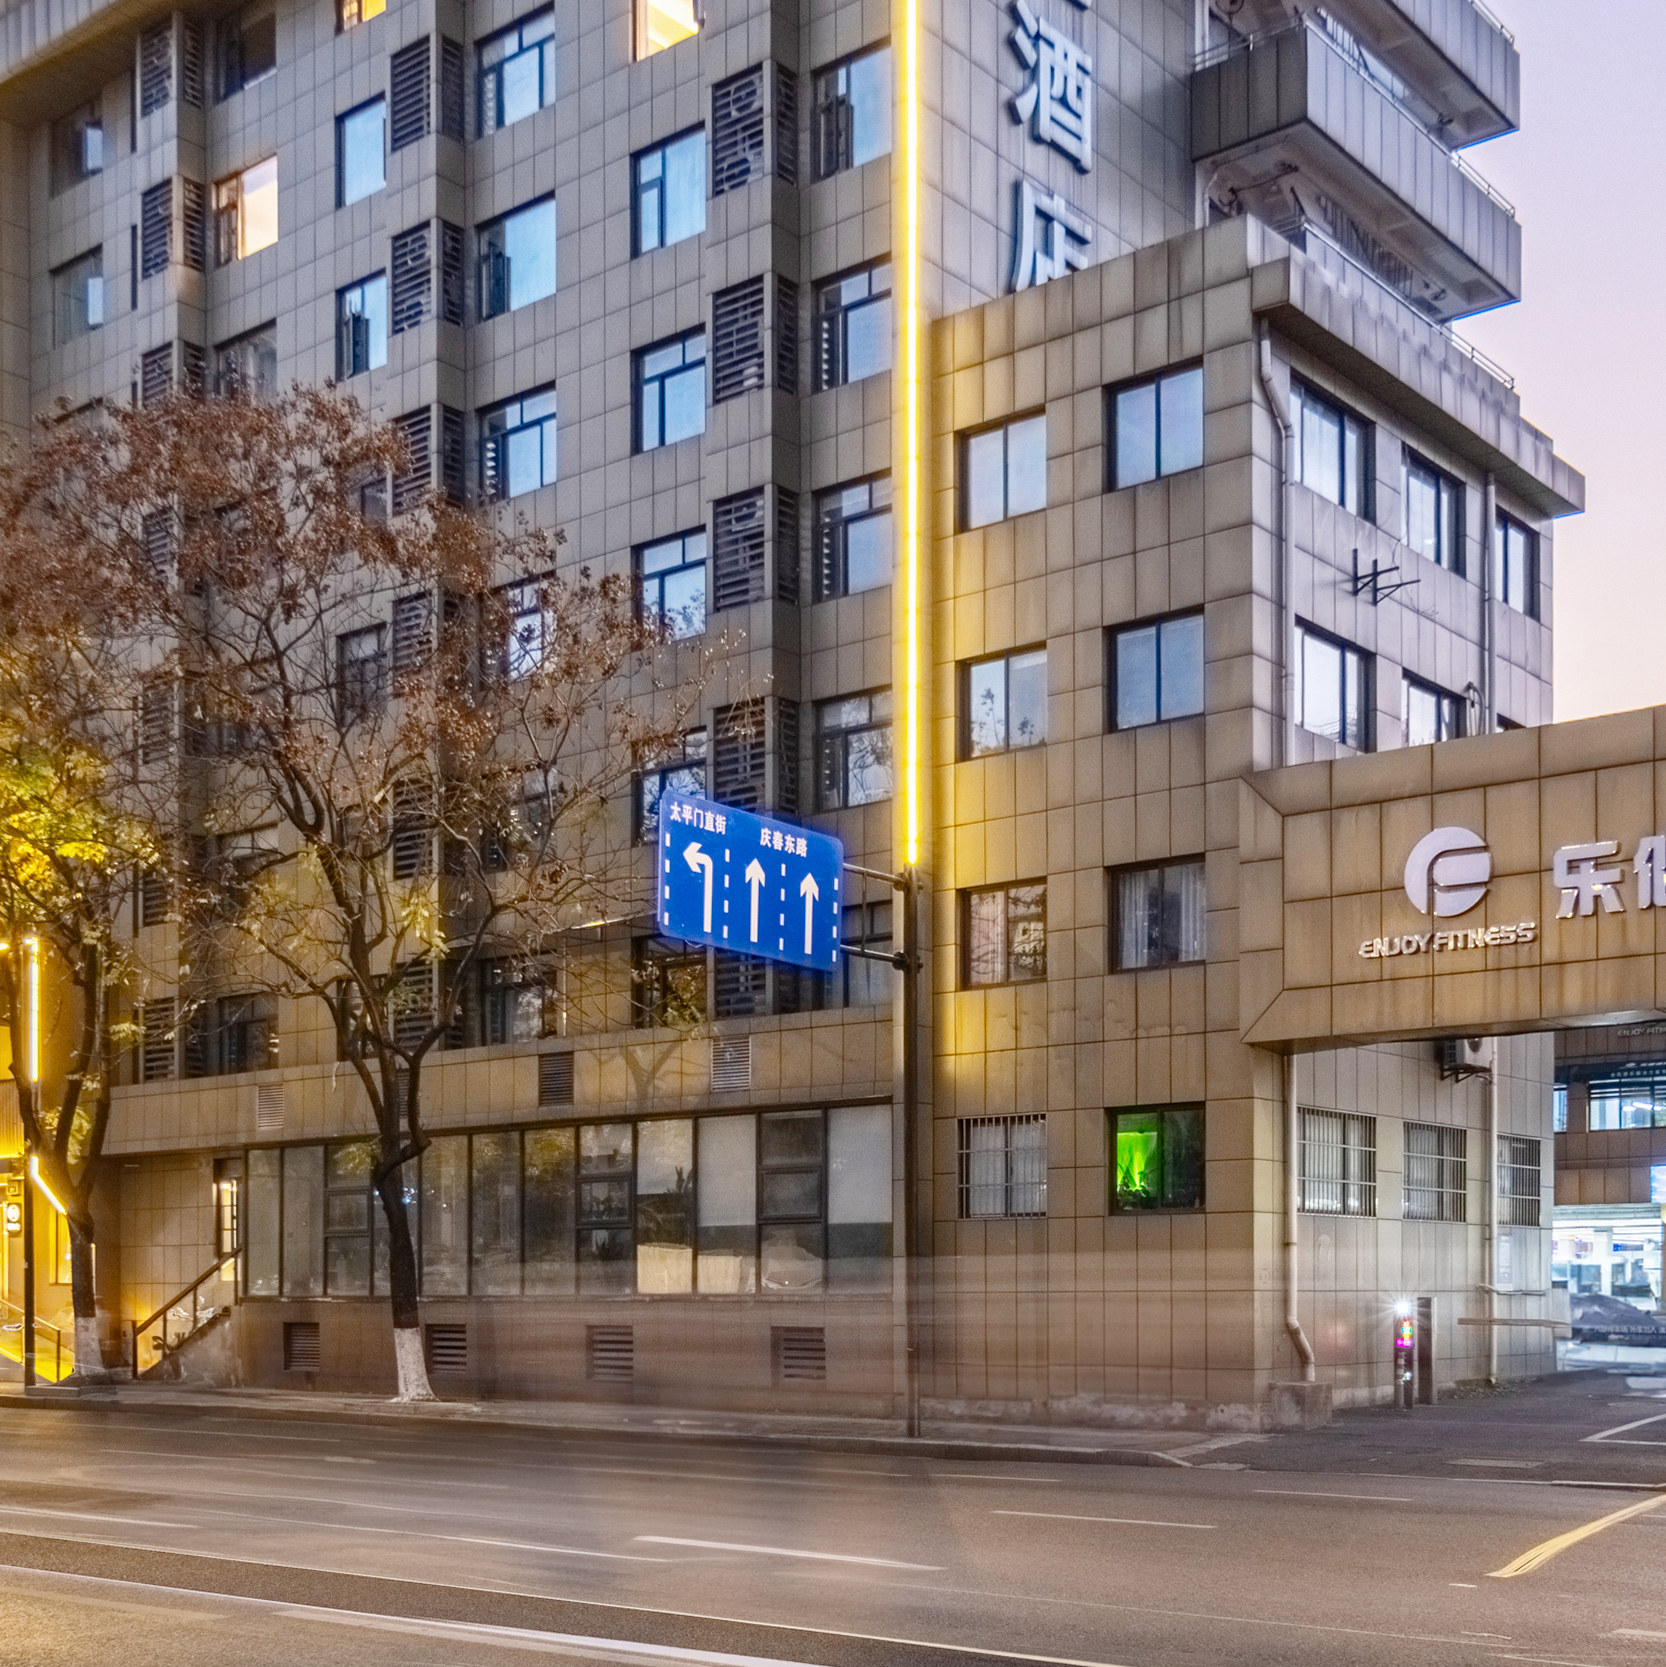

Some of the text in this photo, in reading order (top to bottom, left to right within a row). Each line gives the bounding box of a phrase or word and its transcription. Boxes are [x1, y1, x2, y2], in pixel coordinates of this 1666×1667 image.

[670, 801, 727, 835] 太平门直街
[760, 828, 808, 858] 庆春东路
[1359, 922, 1536, 959] ENJOY FITNESS
